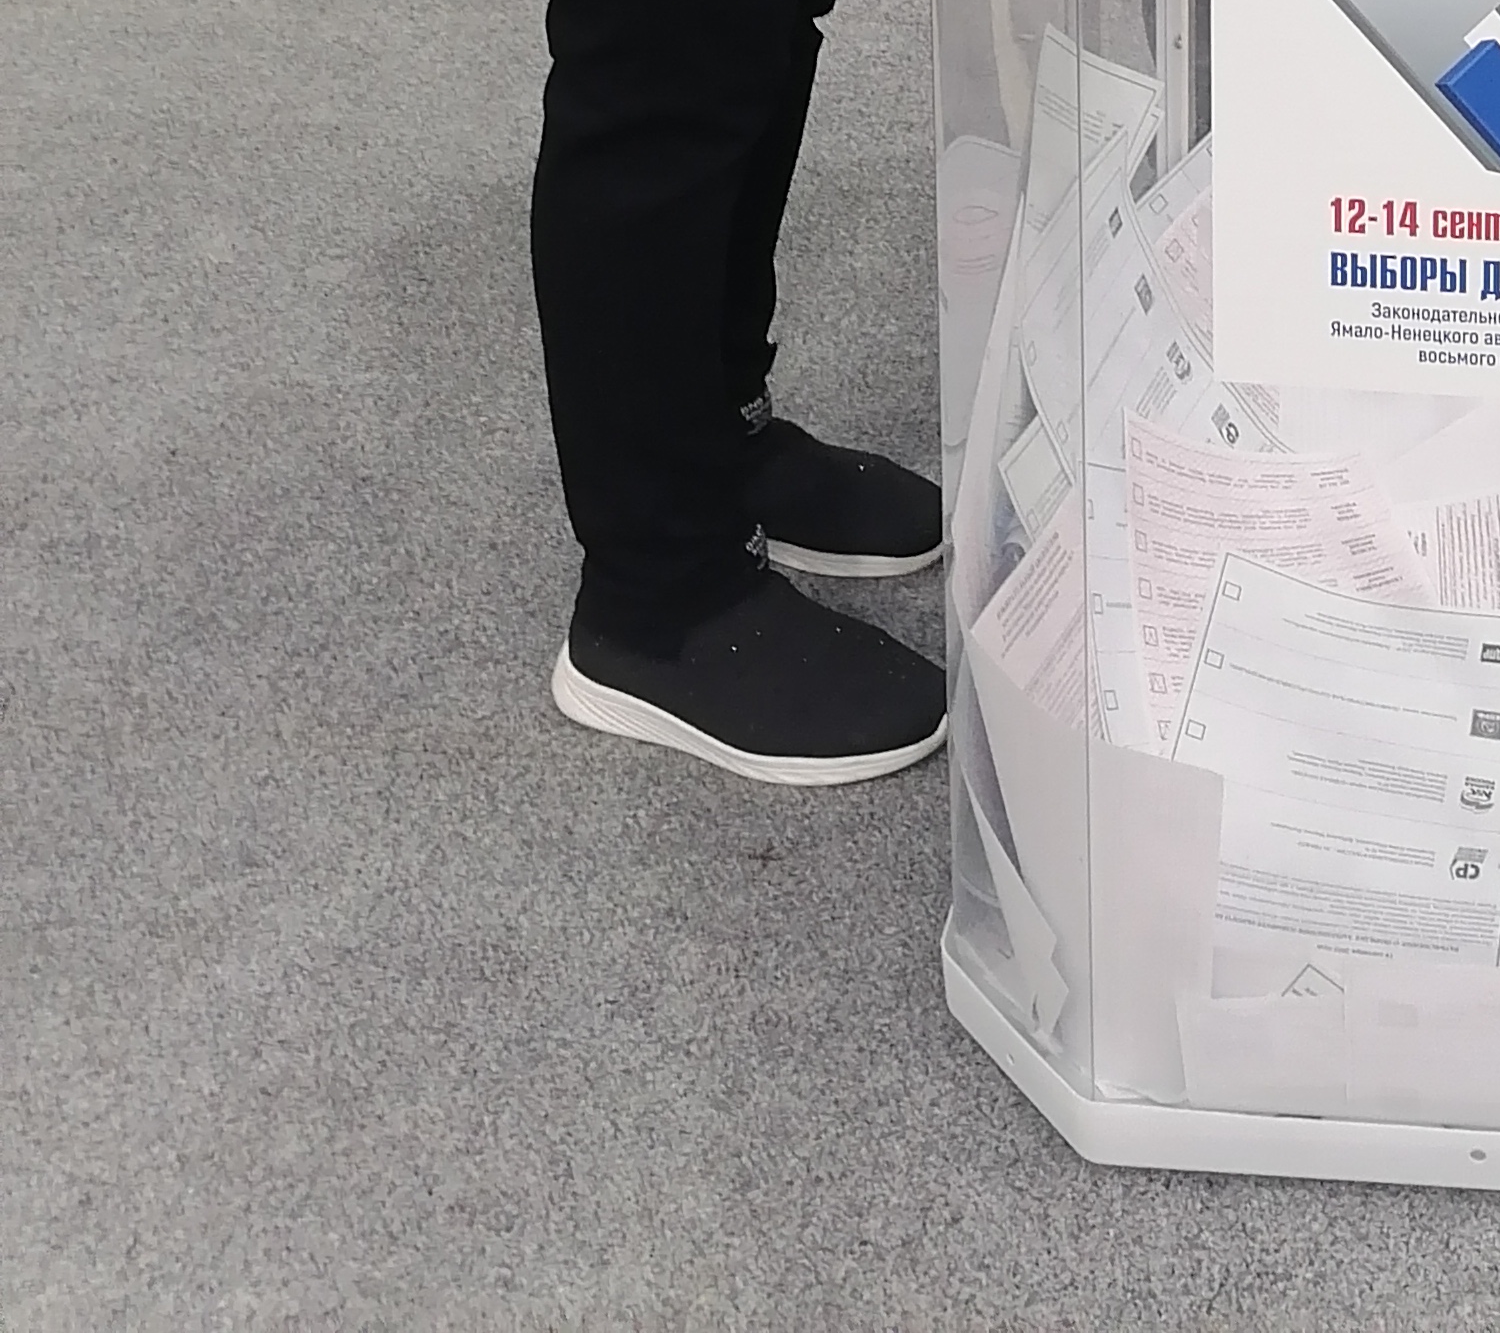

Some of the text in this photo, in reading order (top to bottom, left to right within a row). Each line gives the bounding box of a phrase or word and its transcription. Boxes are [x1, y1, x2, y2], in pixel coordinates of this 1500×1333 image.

[1330, 197, 1419, 237] 12-14
[1330, 252, 1467, 293] ВЫБОРЫ
[1331, 321, 1479, 346] Ямало-Ненецкого
[1418, 350, 1496, 368] восьмого
[1455, 863, 1480, 880] СР
